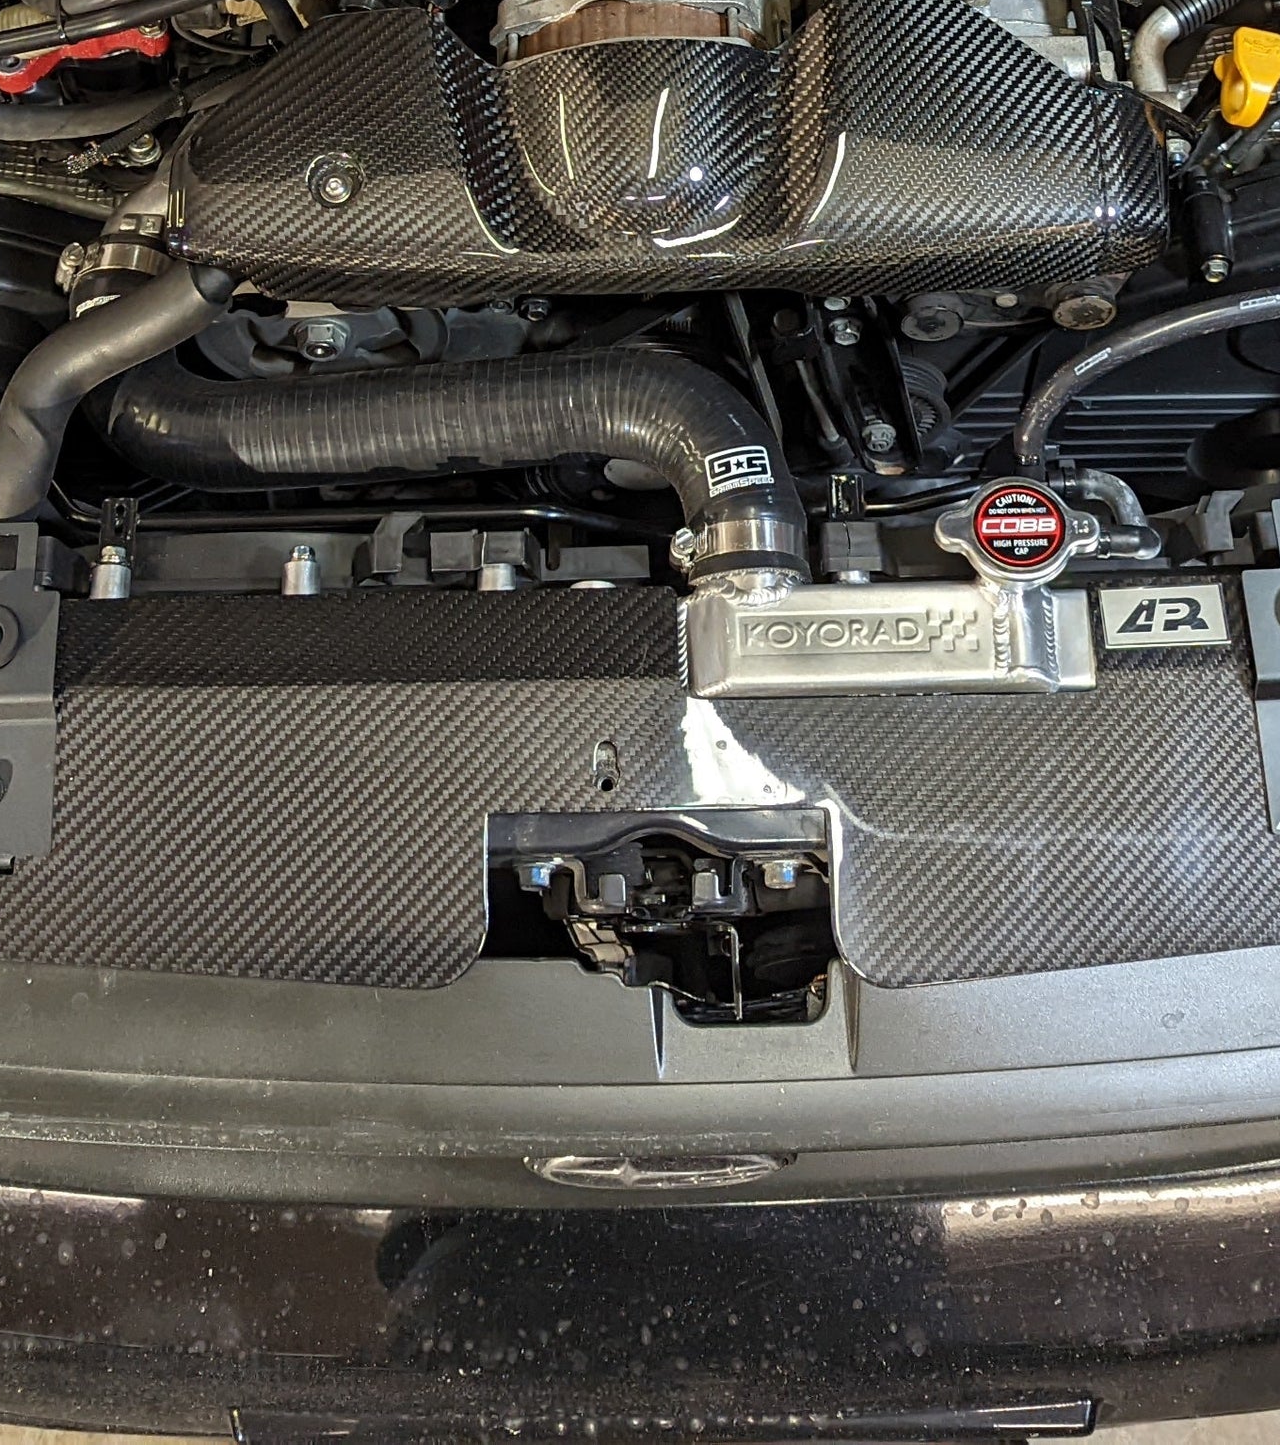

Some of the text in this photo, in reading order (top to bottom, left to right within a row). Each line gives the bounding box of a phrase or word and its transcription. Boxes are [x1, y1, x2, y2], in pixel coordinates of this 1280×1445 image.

[995, 494, 1037, 508] CAUTION!
[981, 519, 1057, 533] COBB
[993, 538, 1049, 547] HIGH PRESSURE
[1014, 547, 1029, 555] CAP
[744, 617, 925, 650] KOYORAD
